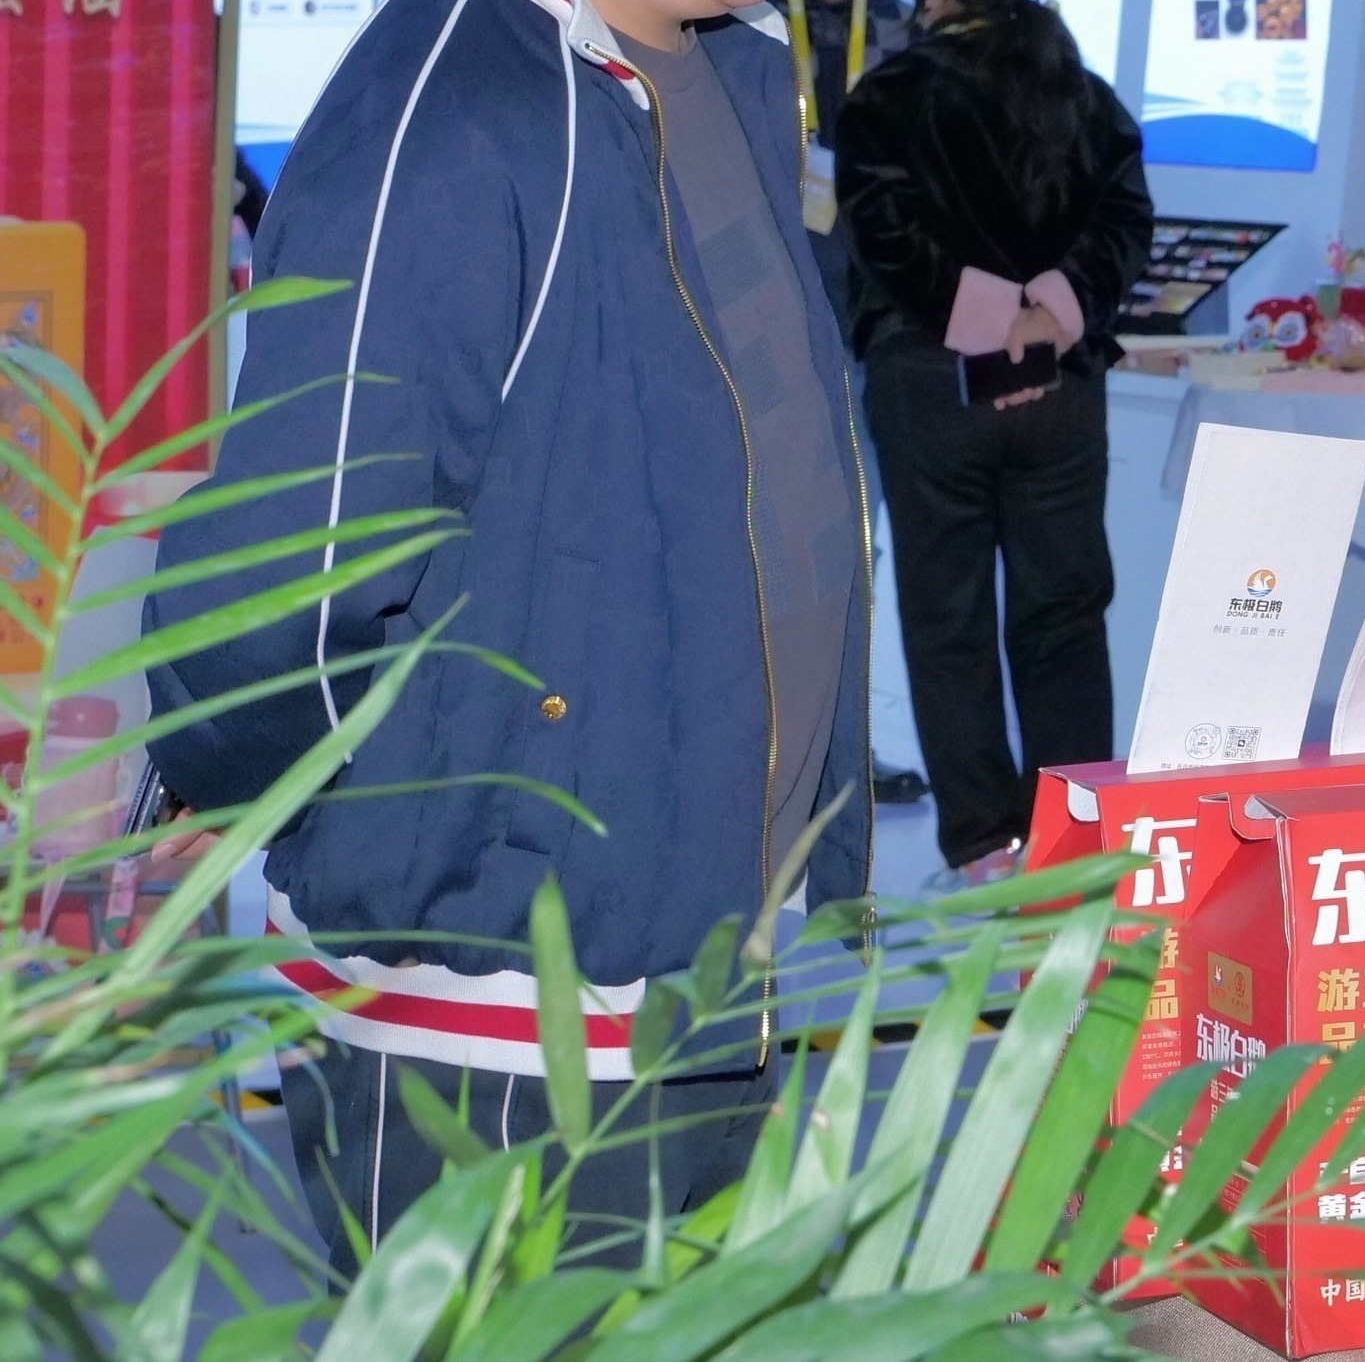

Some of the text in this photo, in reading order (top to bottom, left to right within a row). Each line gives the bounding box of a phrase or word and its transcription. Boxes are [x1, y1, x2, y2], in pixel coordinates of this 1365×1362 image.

[1229, 597, 1283, 614] 东极白鹅
[1226, 610, 1249, 619] DONG
[1260, 612, 1273, 620] BAI
[1196, 1013, 1267, 1079] 东极白鹅
